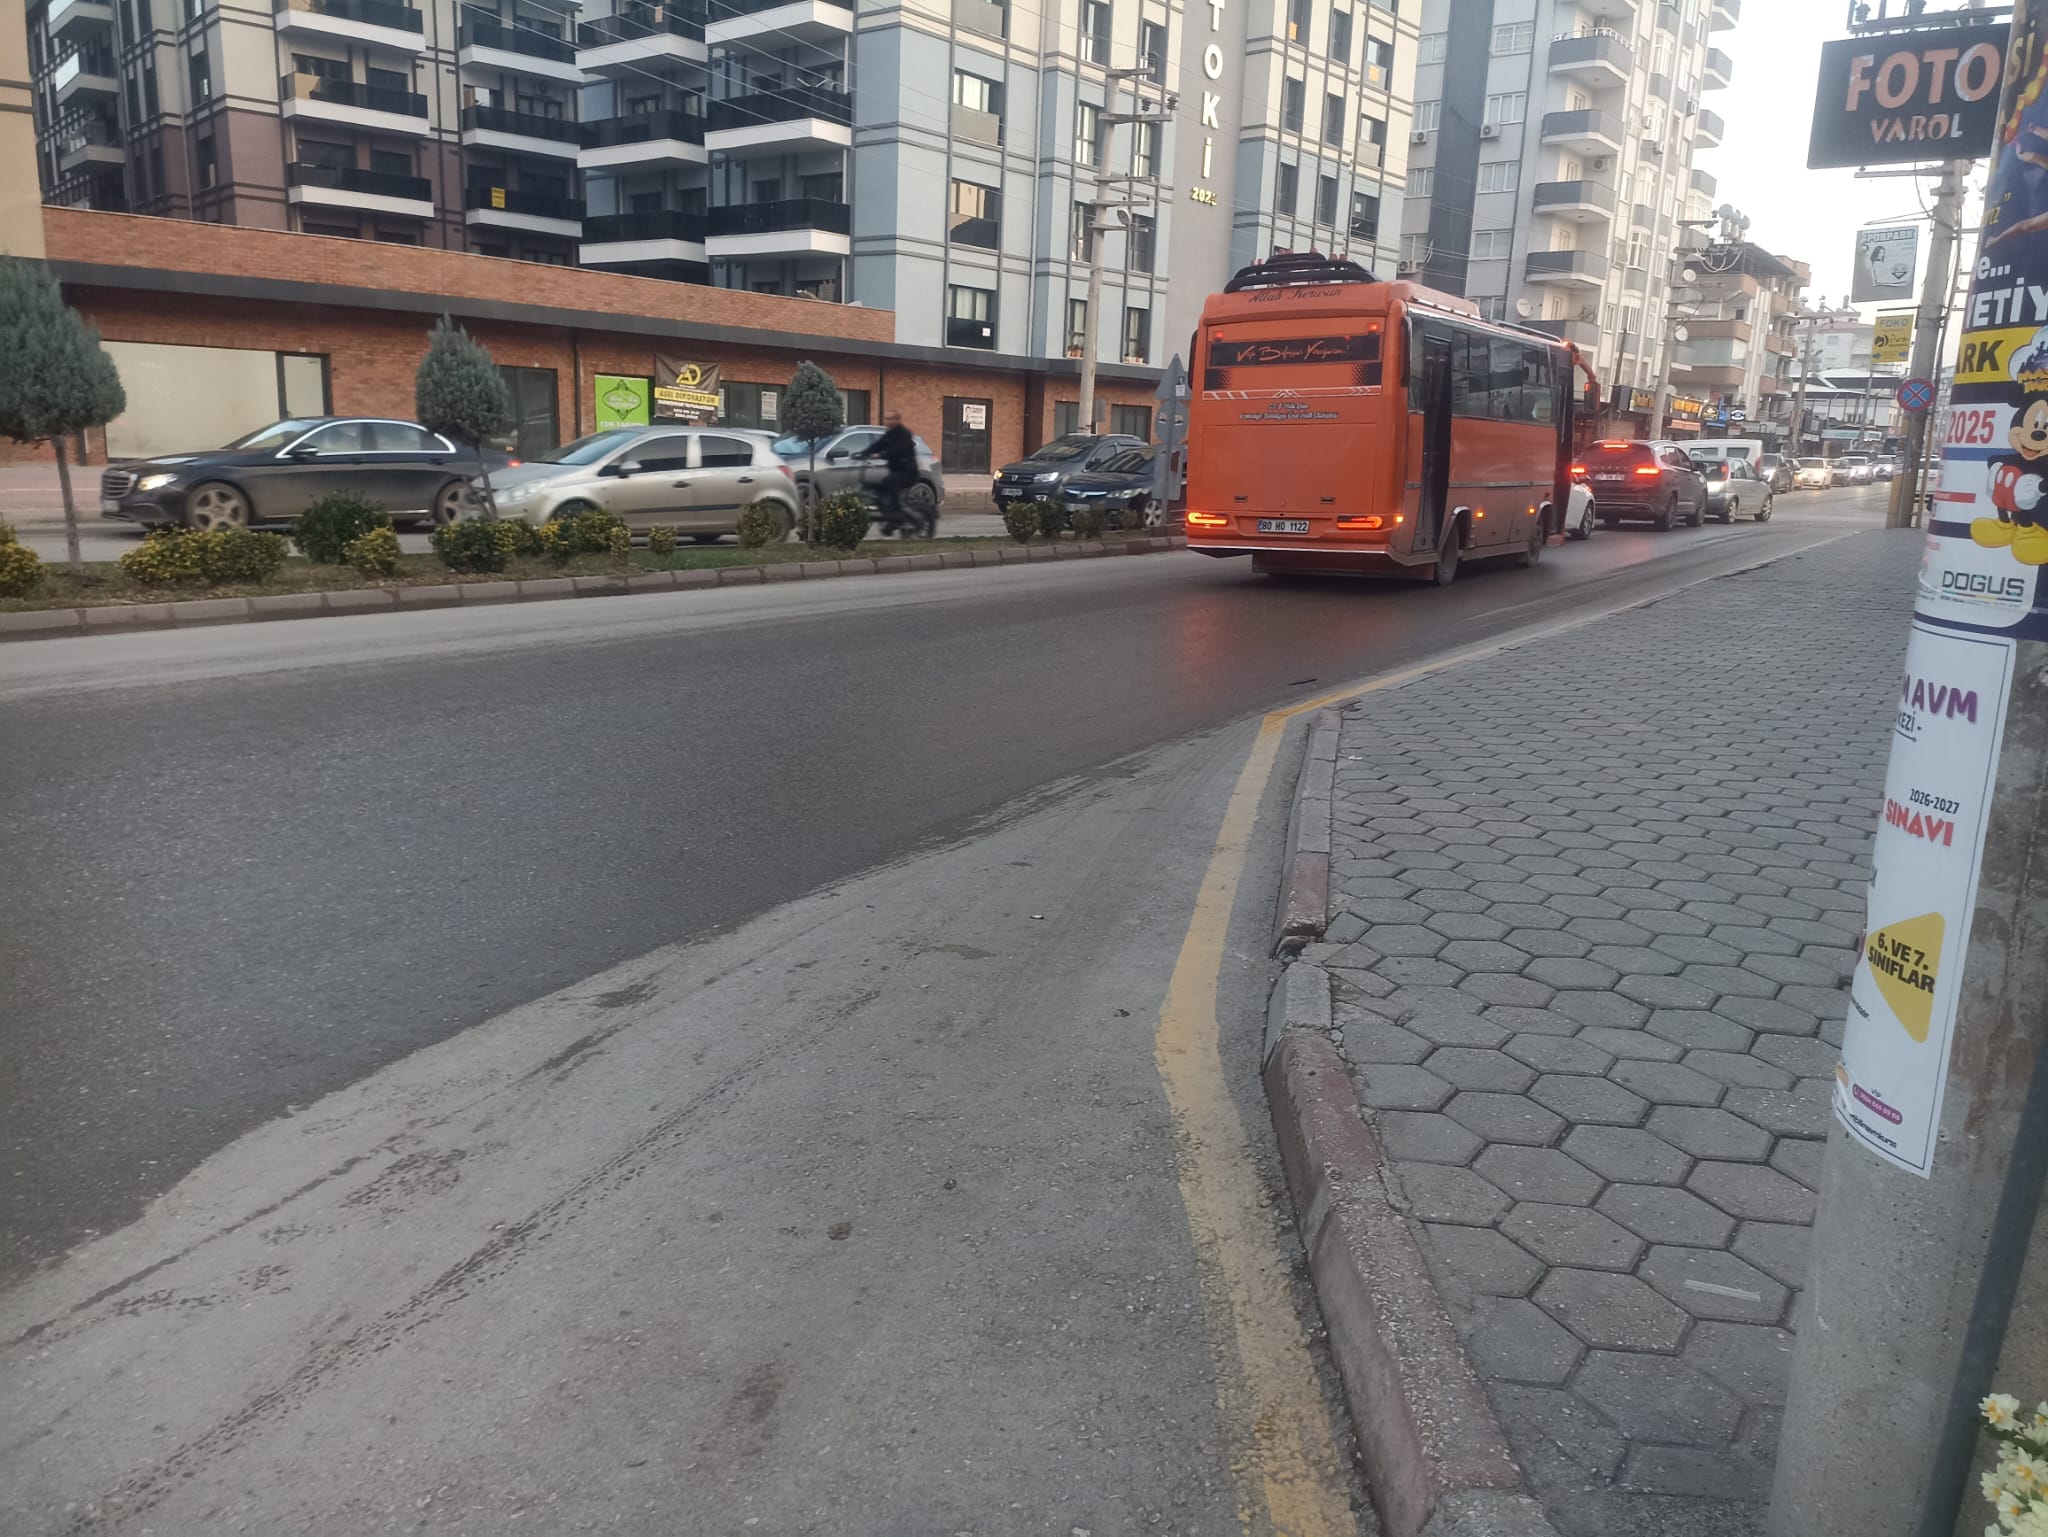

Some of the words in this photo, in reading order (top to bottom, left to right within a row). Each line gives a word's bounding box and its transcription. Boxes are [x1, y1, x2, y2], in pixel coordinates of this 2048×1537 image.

[1845, 43, 2000, 111] FOTO
[1870, 113, 1963, 144] VAROL
[1957, 339, 2004, 373] RK
[1946, 410, 1996, 444] 2025
[1290, 522, 1307, 531] 1122
[1909, 788, 1960, 815] 2026-2027
[1886, 798, 1954, 847] SINAVI
[1877, 932, 1888, 952] 6.
[1891, 938, 1912, 963] VE
[1913, 949, 1929, 971] 7.
[1868, 945, 1936, 994] SINIFLAR
